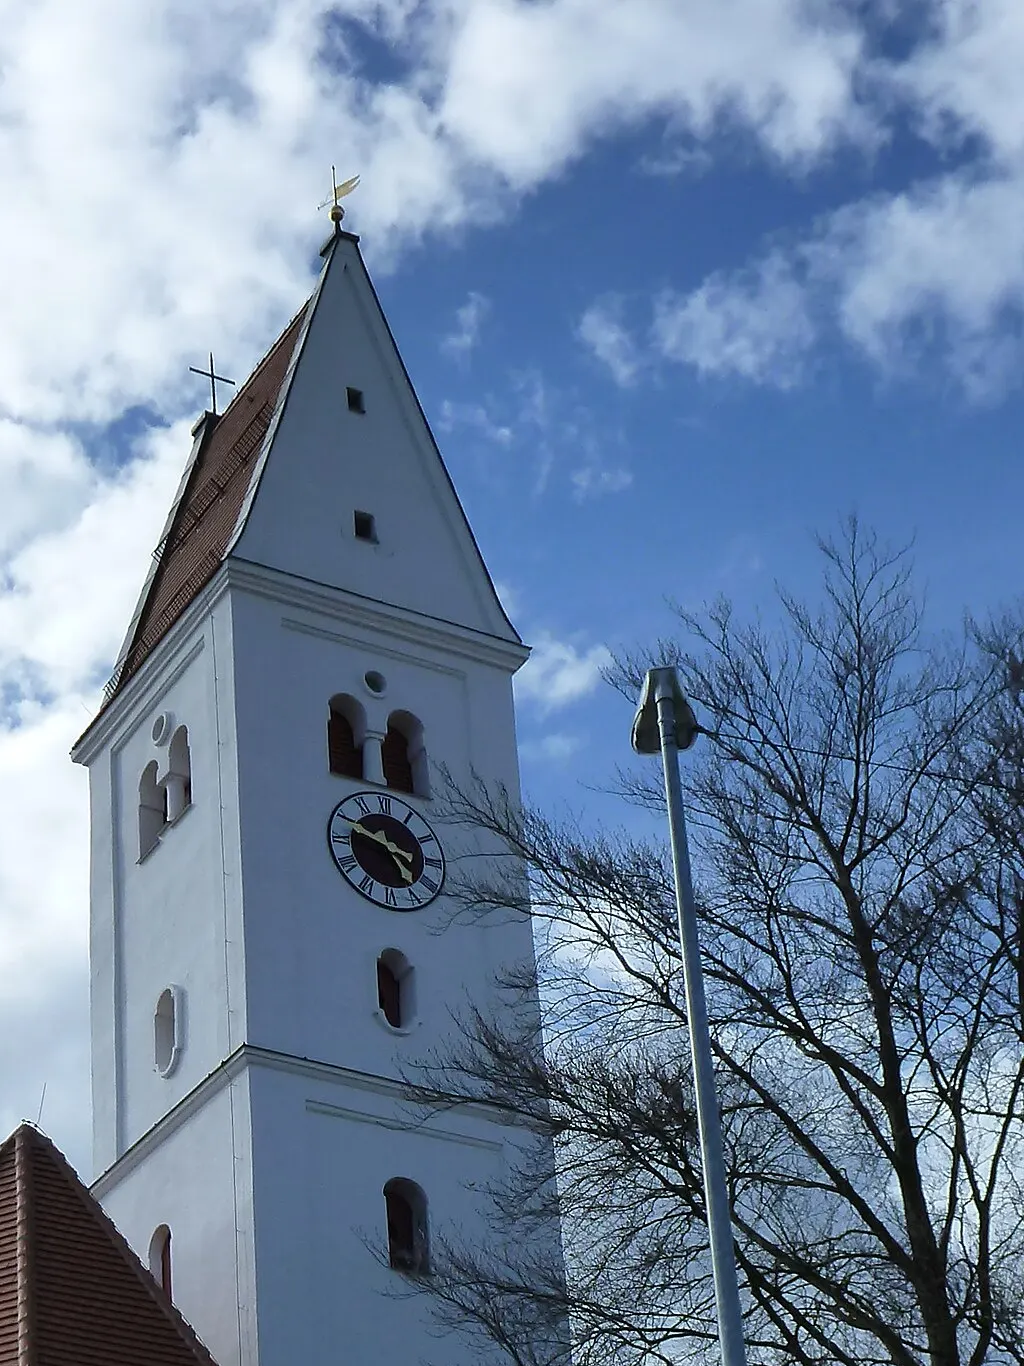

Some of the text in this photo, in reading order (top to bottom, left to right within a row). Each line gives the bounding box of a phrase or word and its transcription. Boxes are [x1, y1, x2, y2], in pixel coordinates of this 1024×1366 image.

[353, 796, 371, 816] XI
[377, 796, 391, 815] XII
[403, 810, 414, 825] I
[332, 831, 350, 846] IX
[417, 833, 434, 844] II
[338, 854, 358, 874] VIII
[425, 856, 442, 869] III
[358, 875, 374, 896] VII
[384, 887, 398, 906] VI
